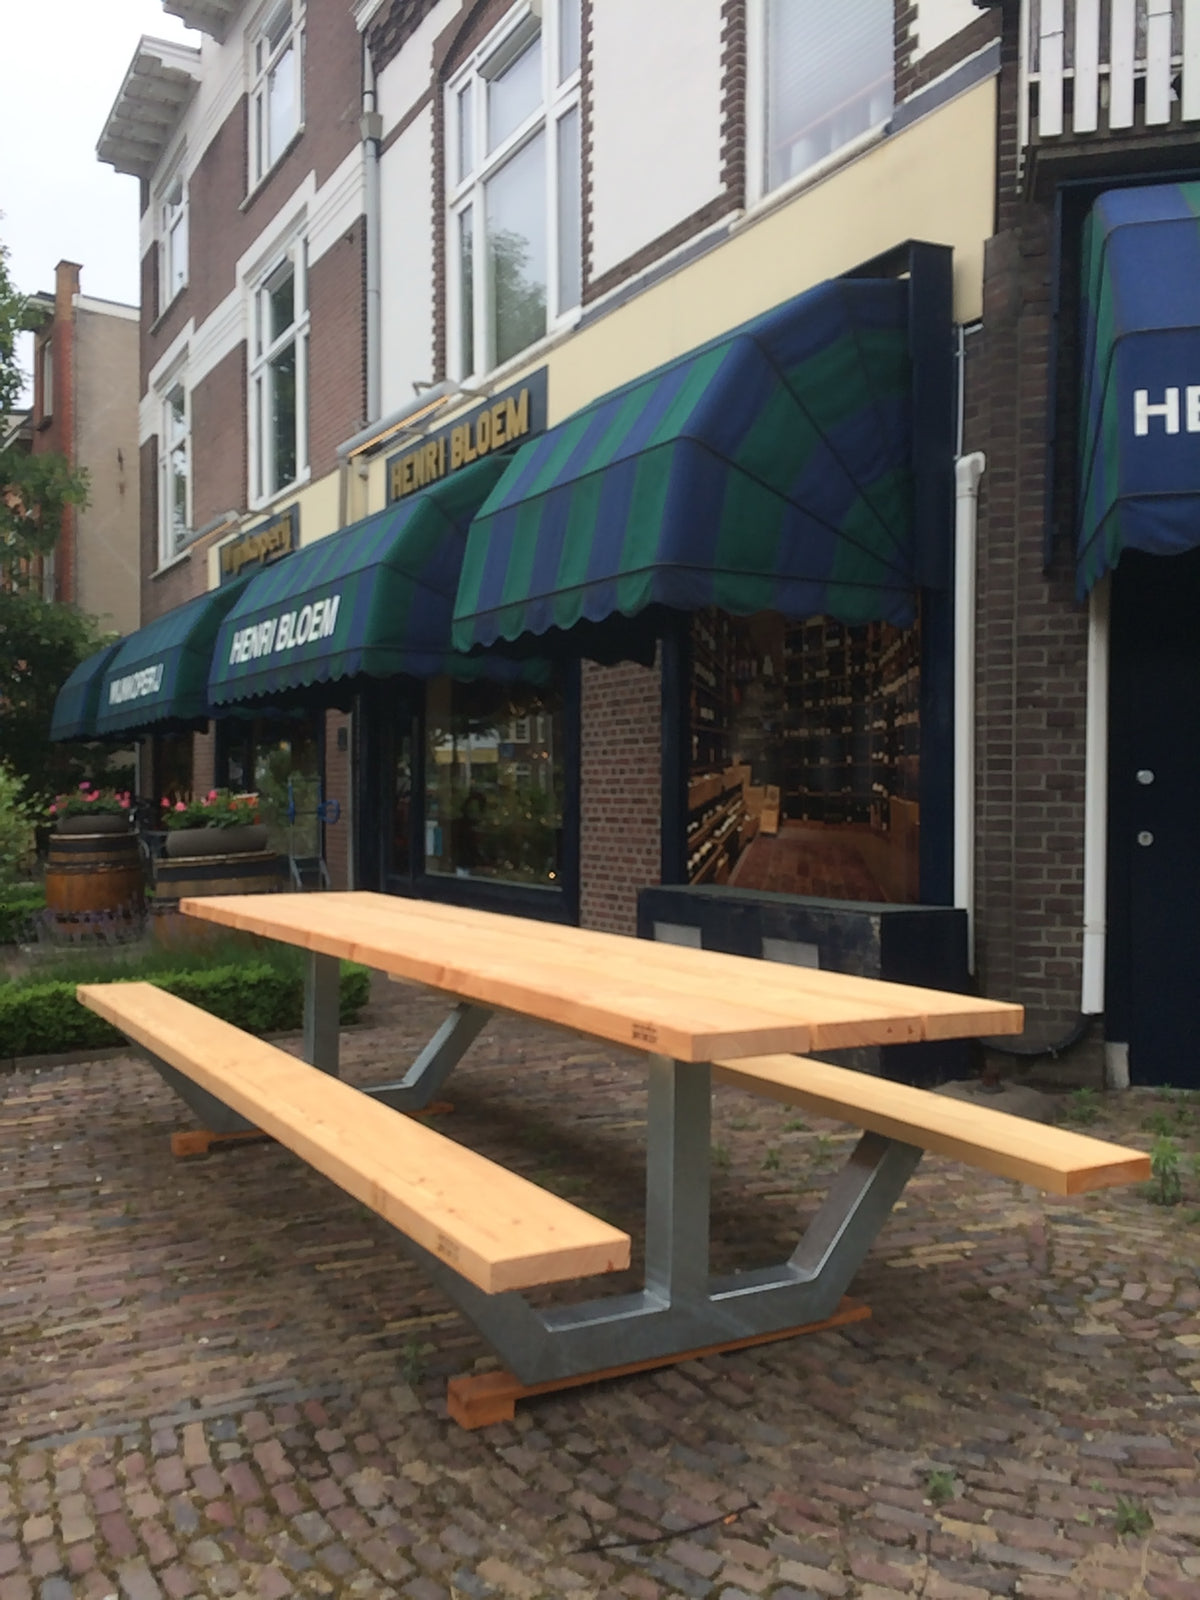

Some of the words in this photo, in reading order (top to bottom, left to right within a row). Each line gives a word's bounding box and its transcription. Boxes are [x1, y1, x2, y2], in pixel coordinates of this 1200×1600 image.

[391, 436, 445, 500] HENRI
[451, 388, 529, 470] BLOEM
[229, 617, 278, 665] HENRI
[274, 595, 341, 652] BLOEM
